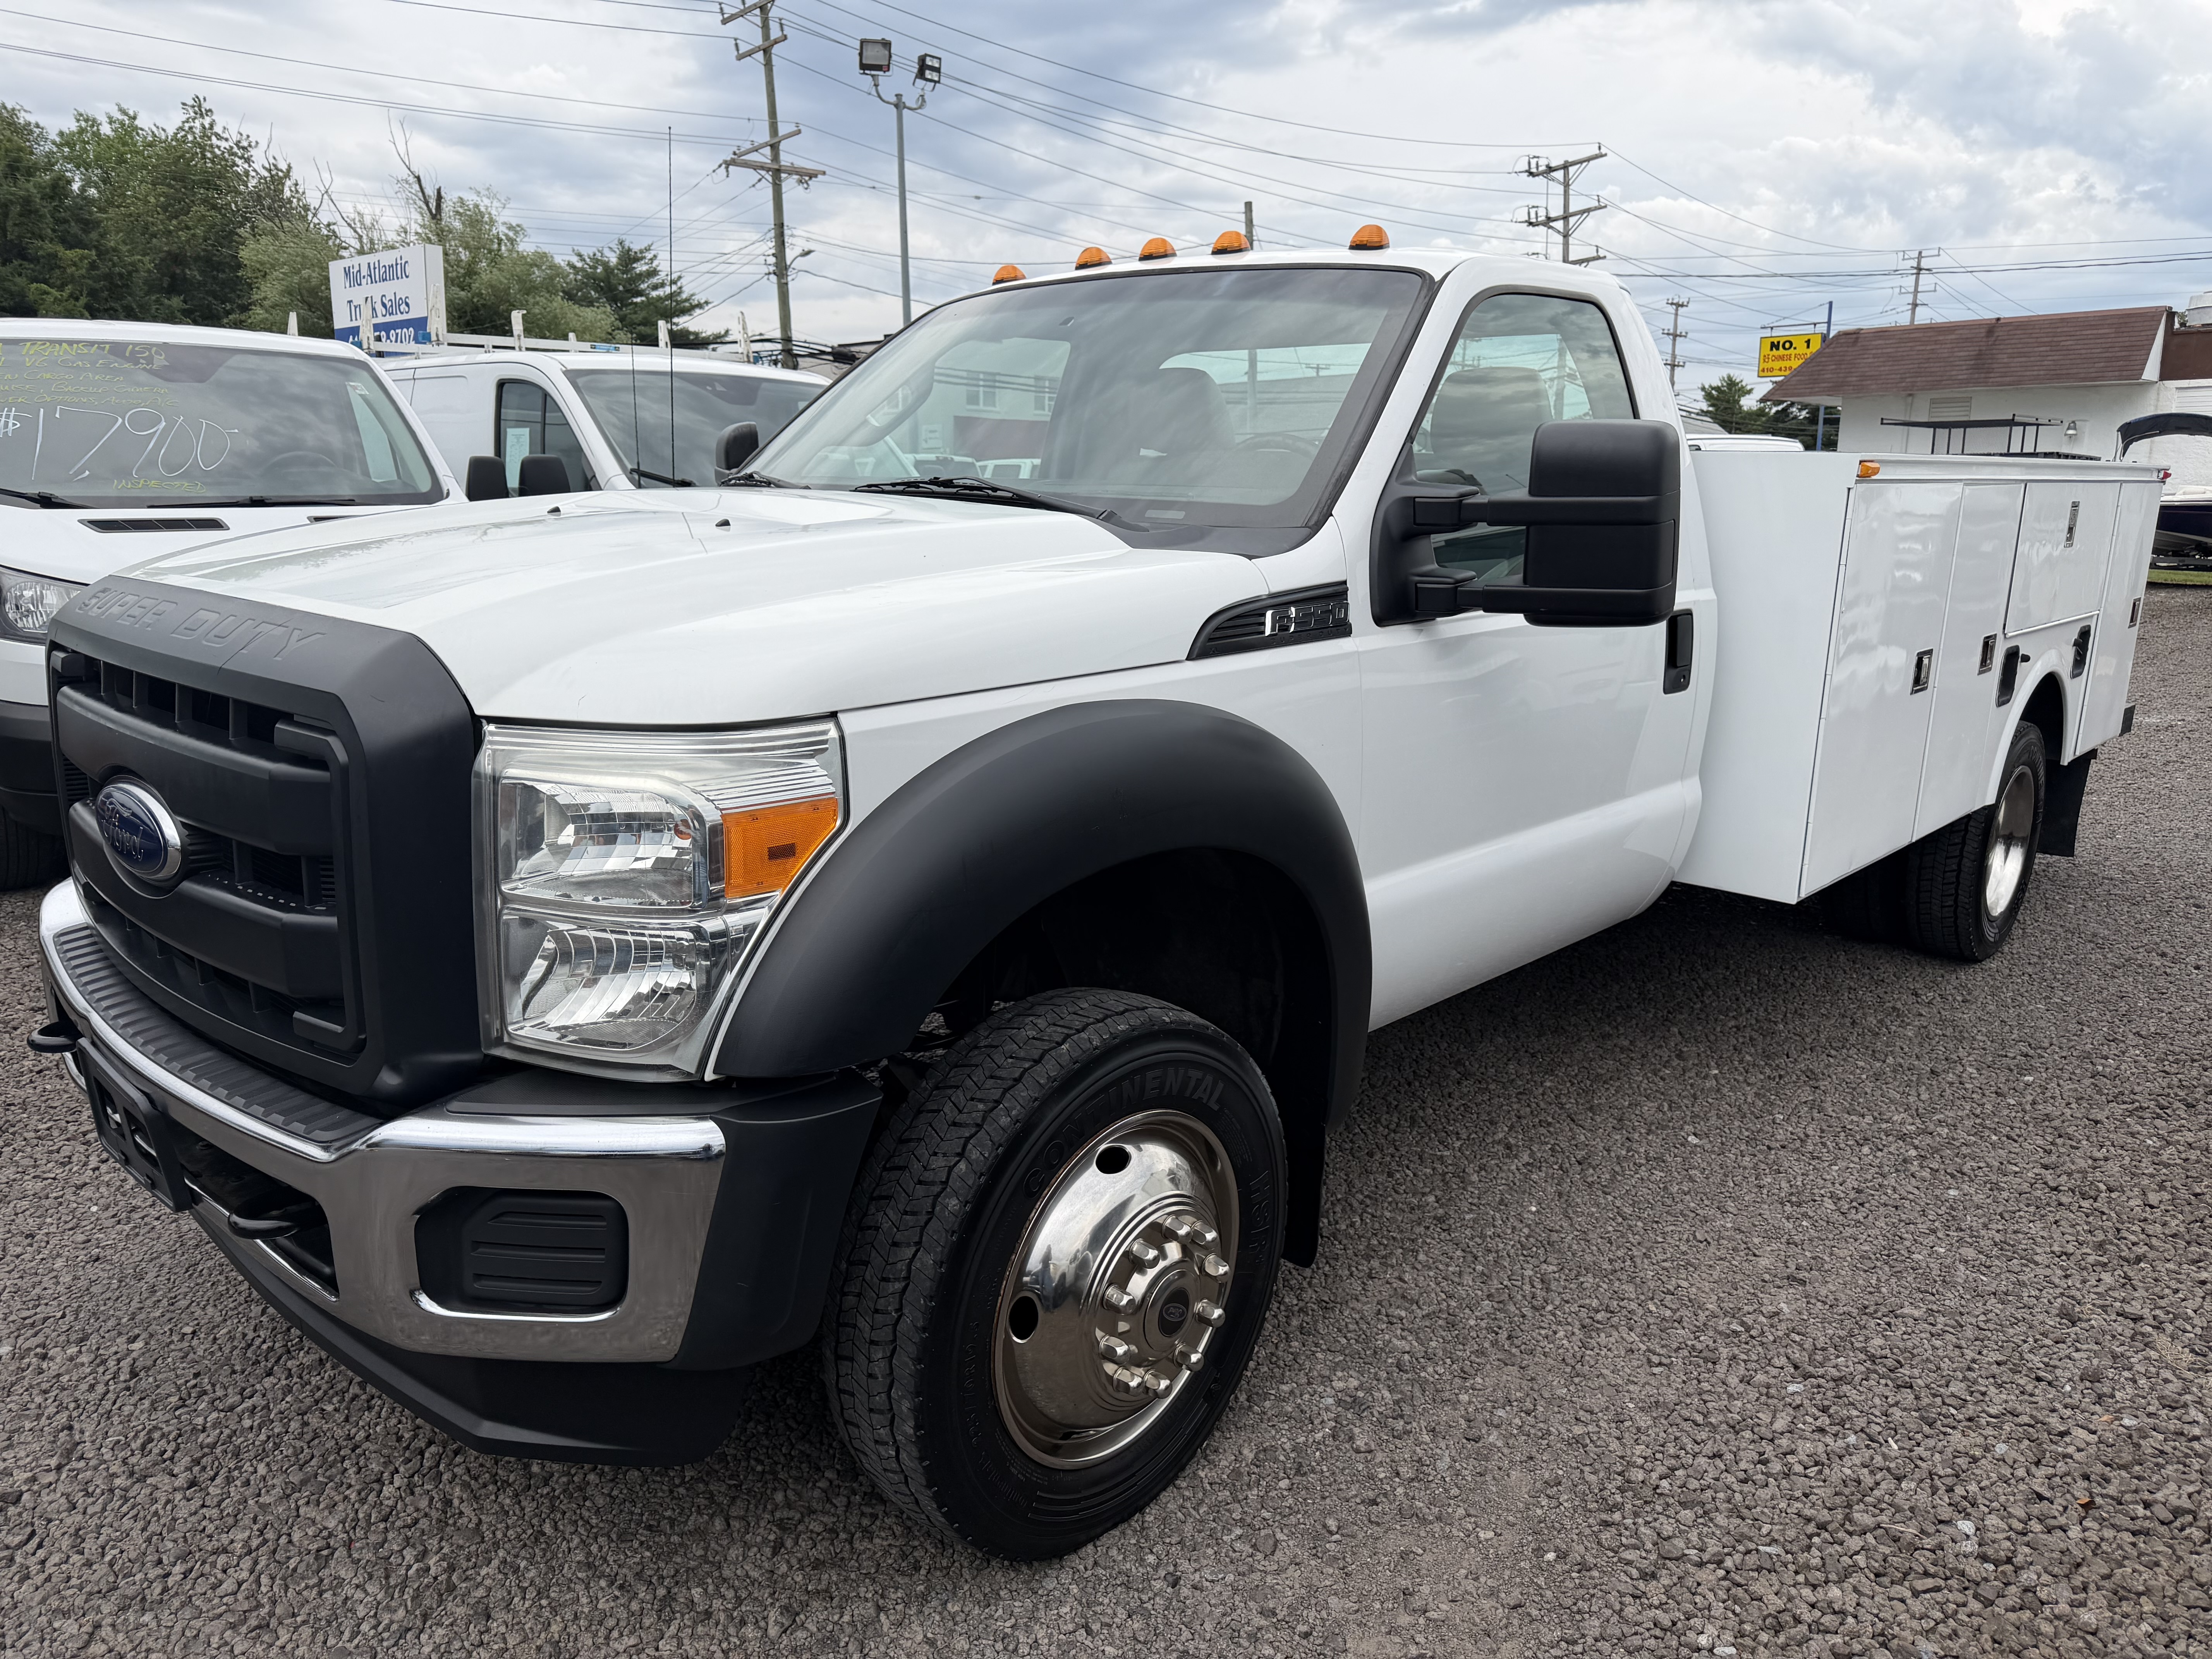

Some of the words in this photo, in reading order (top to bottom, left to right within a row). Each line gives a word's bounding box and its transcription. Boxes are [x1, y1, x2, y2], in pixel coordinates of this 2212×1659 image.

[343, 254, 410, 289] Mid-Atlantic
[347, 295, 378, 322] Trk
[381, 291, 410, 318] Sales
[19, 341, 115, 356] TRANSIT
[126, 344, 166, 360] 150
[1770, 340, 1797, 351] NO.
[1804, 338, 1811, 349] 1
[26, 357, 48, 367] V6
[1771, 353, 1792, 362] CHINESE
[1794, 352, 1808, 361] FOOD
[113, 479, 206, 493] INSPECTED
[76, 587, 178, 630] SUPER
[170, 608, 327, 660] DUTY
[1023, 1068, 1224, 1199] CONTINENTAL
